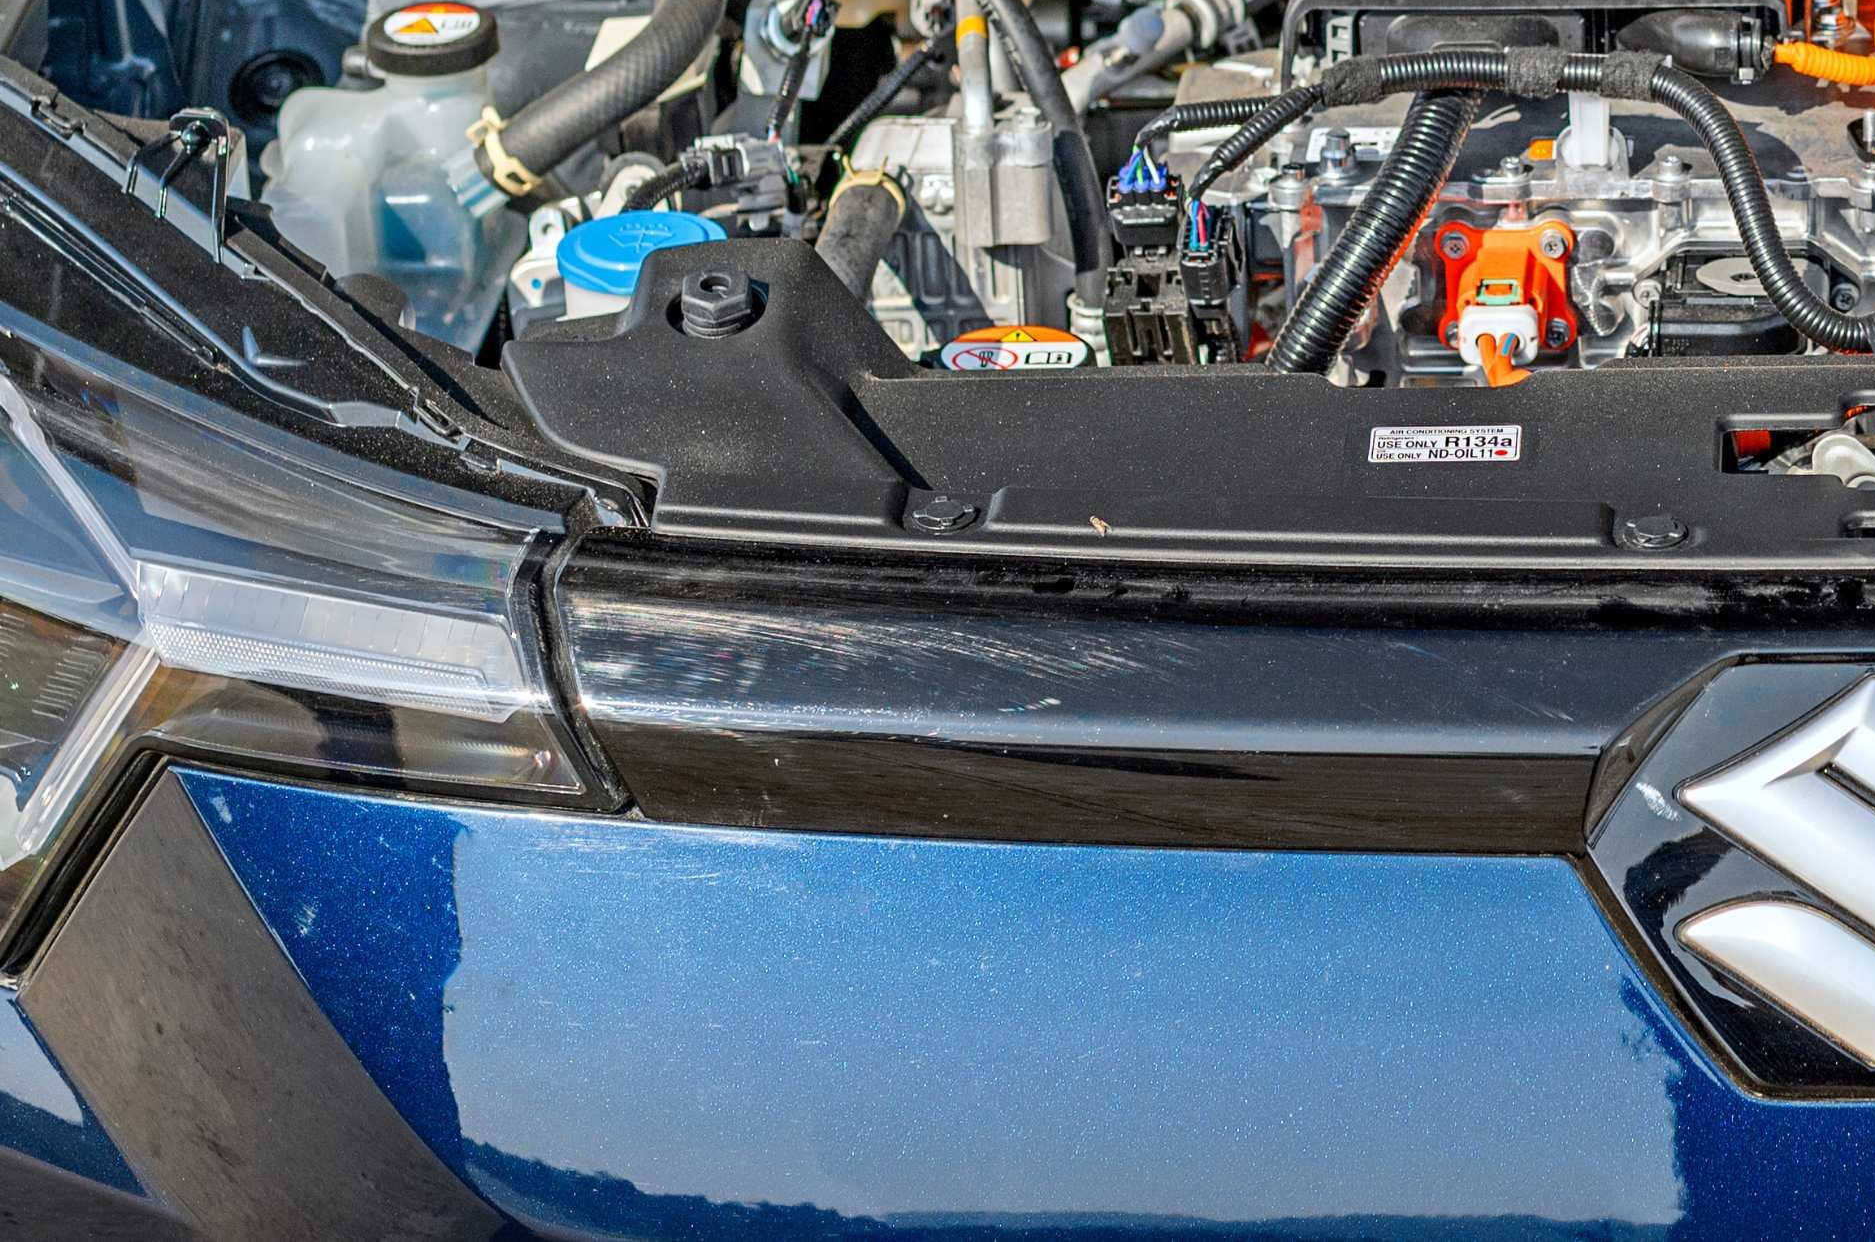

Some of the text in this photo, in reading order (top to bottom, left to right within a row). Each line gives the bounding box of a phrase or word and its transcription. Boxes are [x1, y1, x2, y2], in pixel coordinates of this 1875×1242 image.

[1406, 440, 1437, 448] ONLY
[1445, 436, 1513, 447] R134a
[1397, 452, 1422, 460] ONLY
[1428, 449, 1493, 459] ND-OIL11
